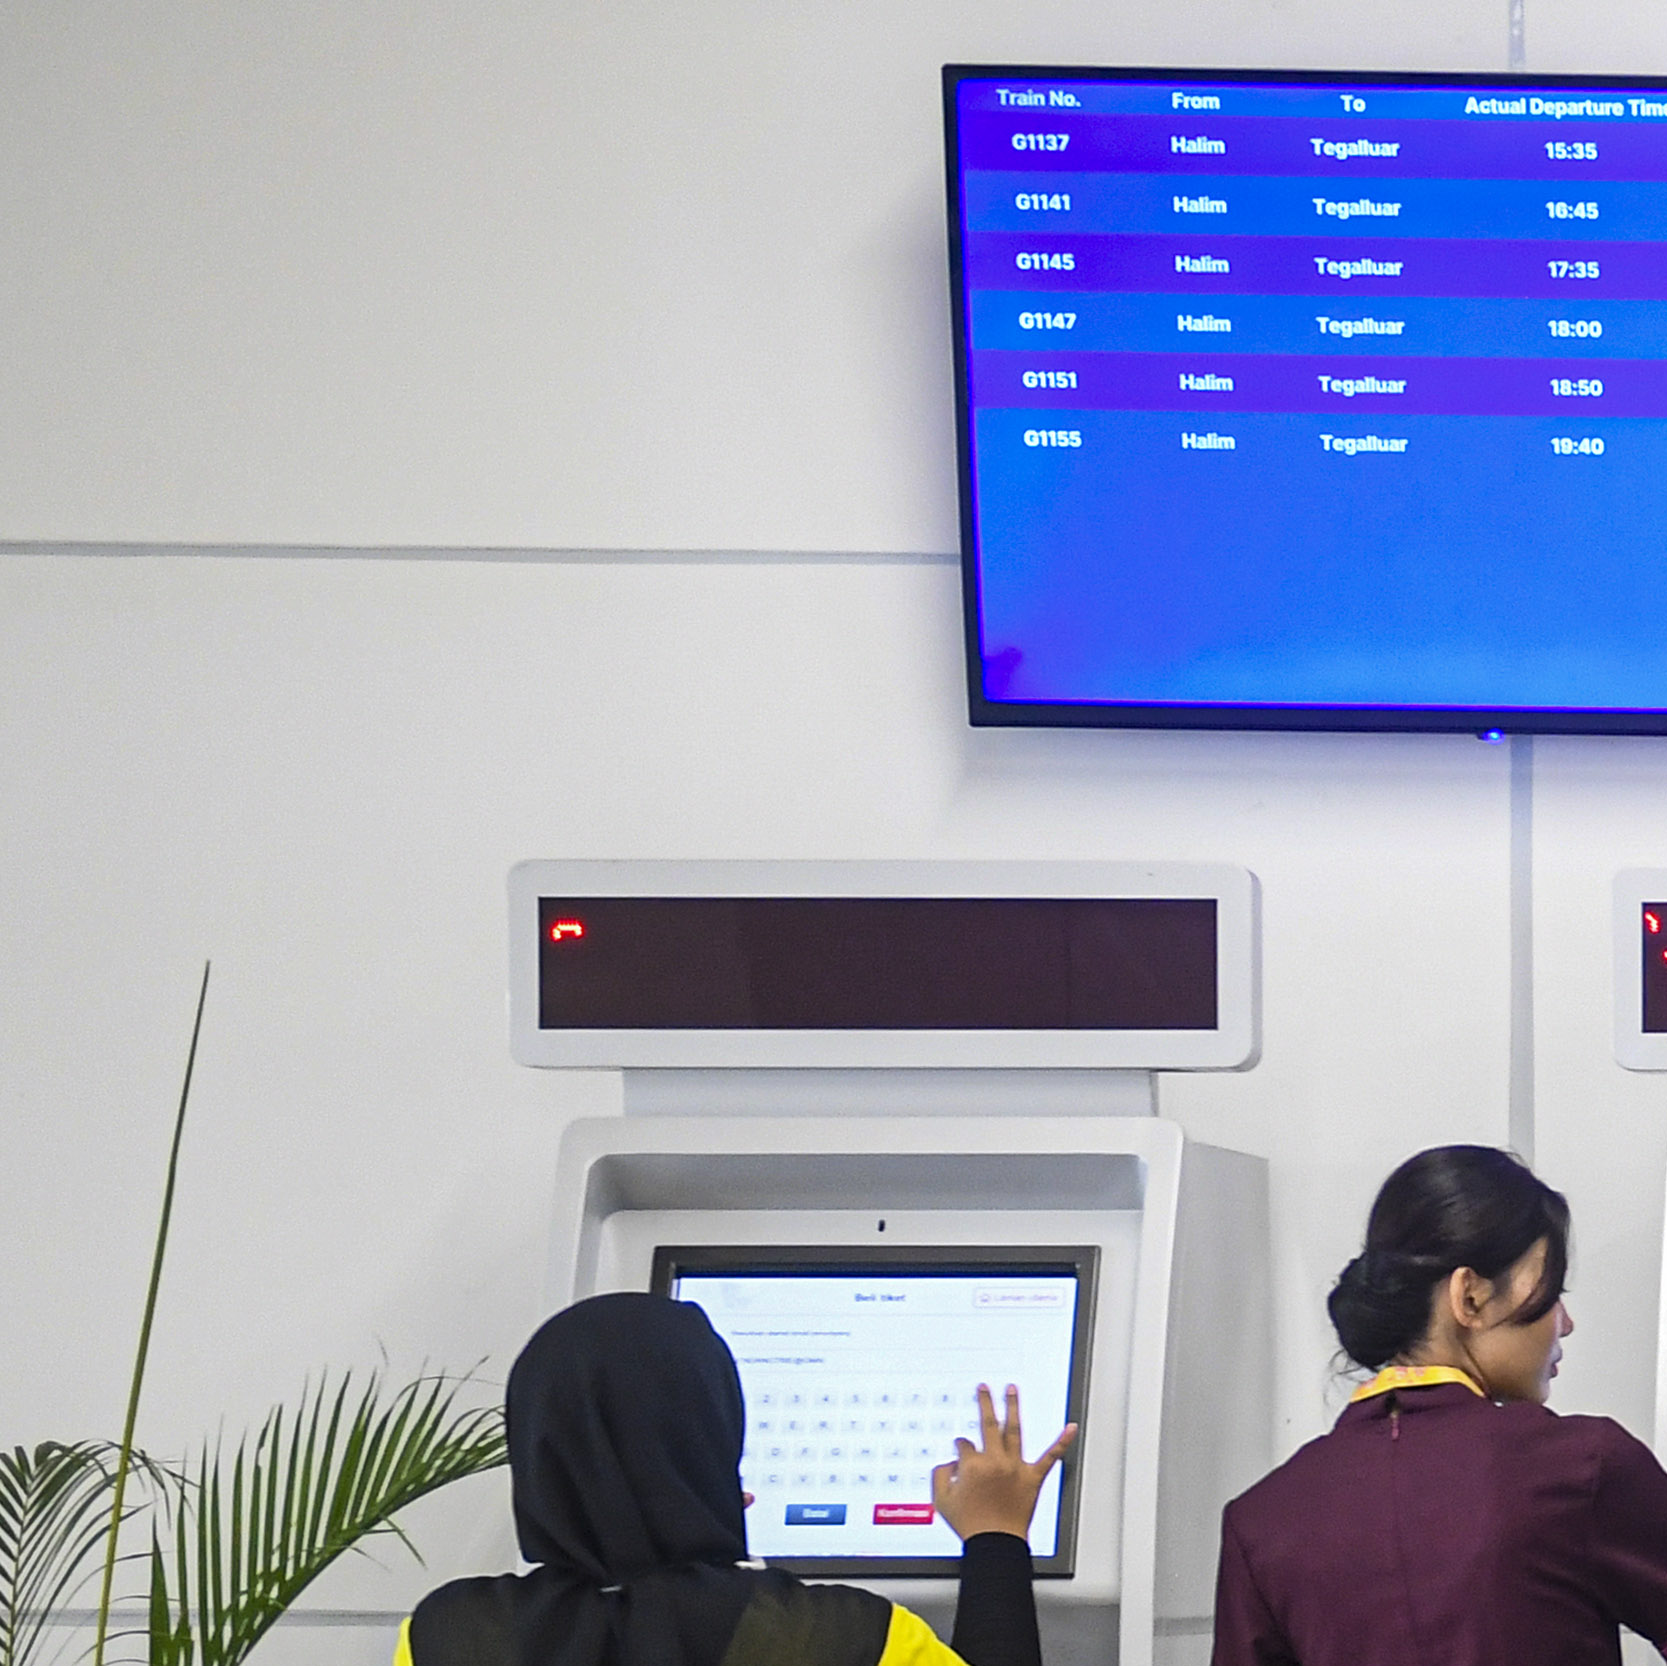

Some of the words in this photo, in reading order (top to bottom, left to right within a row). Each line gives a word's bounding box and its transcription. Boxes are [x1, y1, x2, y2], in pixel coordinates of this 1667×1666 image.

[997, 89, 1046, 107] Train
[1048, 90, 1082, 108] No.
[1171, 91, 1221, 110] From
[1339, 94, 1367, 113] To
[1464, 96, 1527, 115] Actual
[1529, 97, 1625, 120] Departure
[1009, 131, 1072, 153] G1137
[1169, 134, 1227, 156] Halim
[1308, 136, 1402, 162] Tegalluar
[1542, 140, 1599, 161] 15:35
[1014, 191, 1072, 212] G1141
[1171, 194, 1229, 215] Halim
[1310, 196, 1404, 222] Tegalluar
[1543, 199, 1601, 221] 16:45
[1014, 250, 1077, 272] G1145
[1173, 253, 1231, 275] Halim
[1312, 255, 1405, 281] Tegalluar
[1546, 259, 1601, 280] 17:35
[1017, 310, 1078, 331] G1147
[1175, 312, 1233, 334] Halim
[1313, 315, 1407, 340] Tegalluar
[1546, 318, 1604, 340] 18:00
[1021, 369, 1079, 390] G1151
[1177, 371, 1235, 393] Halim
[1315, 374, 1408, 398] Tegalluar
[1548, 377, 1604, 398] 18:50
[1022, 428, 1084, 449] G1155
[1180, 431, 1237, 451] Halim
[1318, 433, 1410, 457] Tegalluar
[1549, 436, 1606, 457] 19:40
